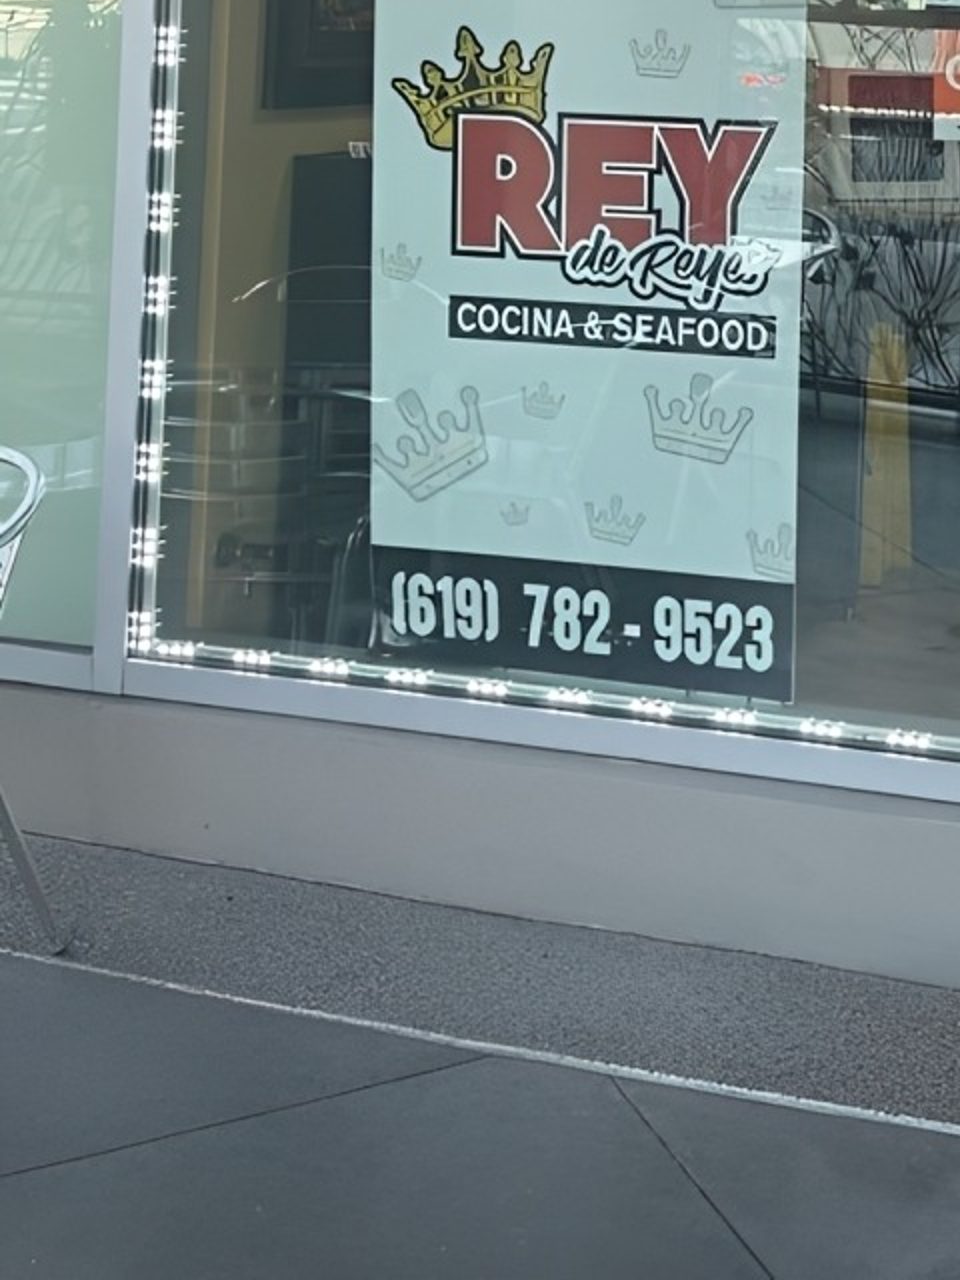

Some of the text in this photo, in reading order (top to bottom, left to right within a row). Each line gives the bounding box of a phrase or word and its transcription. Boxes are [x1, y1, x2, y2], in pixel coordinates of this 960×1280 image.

[453, 113, 776, 259] REY
[570, 229, 626, 275] de
[456, 301, 769, 352] COCINA & SEAFOOD
[391, 571, 499, 642] (619)
[522, 582, 611, 656] 782
[653, 595, 774, 673] 9523
